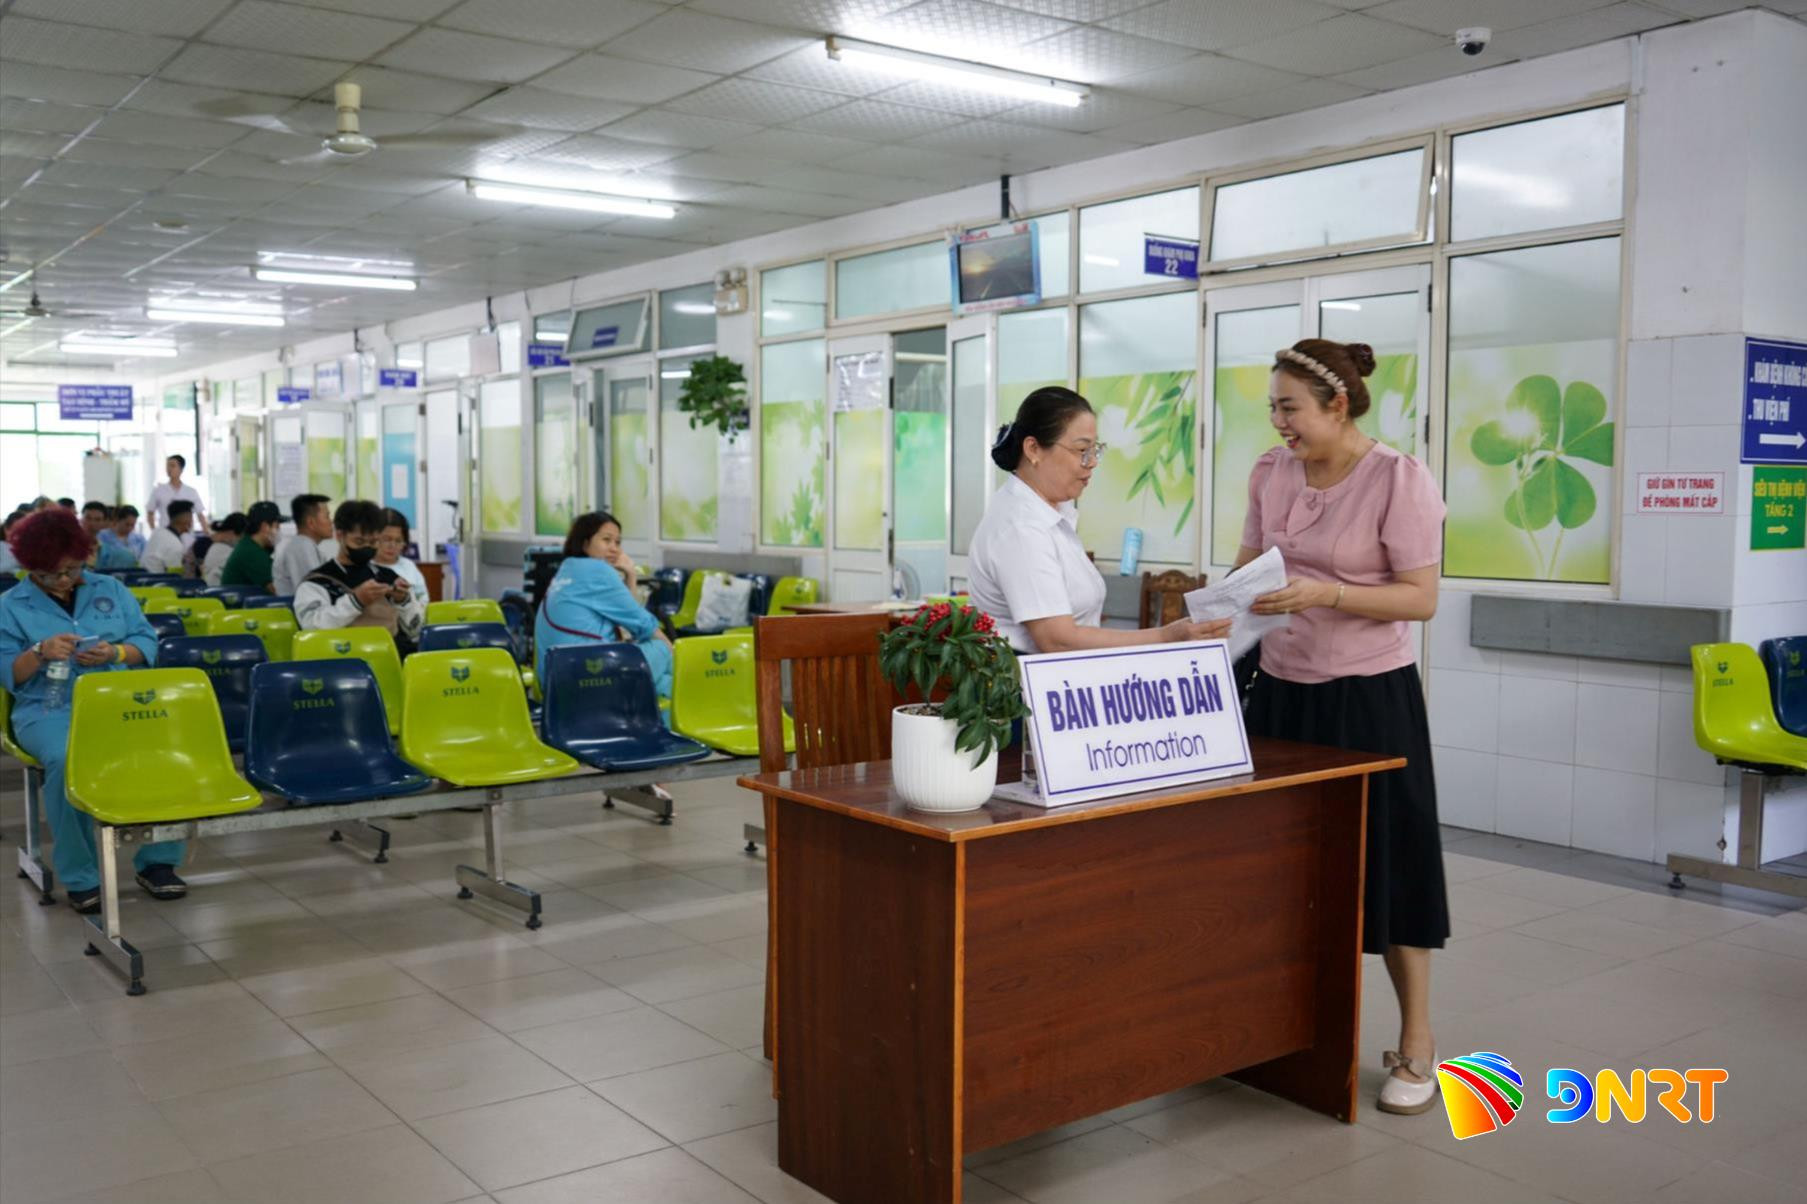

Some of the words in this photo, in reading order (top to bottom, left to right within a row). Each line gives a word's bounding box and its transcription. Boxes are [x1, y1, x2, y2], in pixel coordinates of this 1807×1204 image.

[1164, 258, 1178, 275] 22
[1689, 478, 1714, 489] TRANG
[1654, 494, 1680, 507] PHÒNG
[1787, 504, 1793, 517] 2
[704, 668, 736, 679] STELLA
[578, 677, 613, 688] STELLA
[442, 686, 480, 698] STELLA
[1046, 680, 1098, 732] BÀN
[1100, 674, 1176, 726] HƯỚNG
[1177, 661, 1224, 716] DẪN
[293, 698, 335, 710] STELLA
[122, 709, 169, 721] STELLA
[1086, 732, 1207, 772] Information
